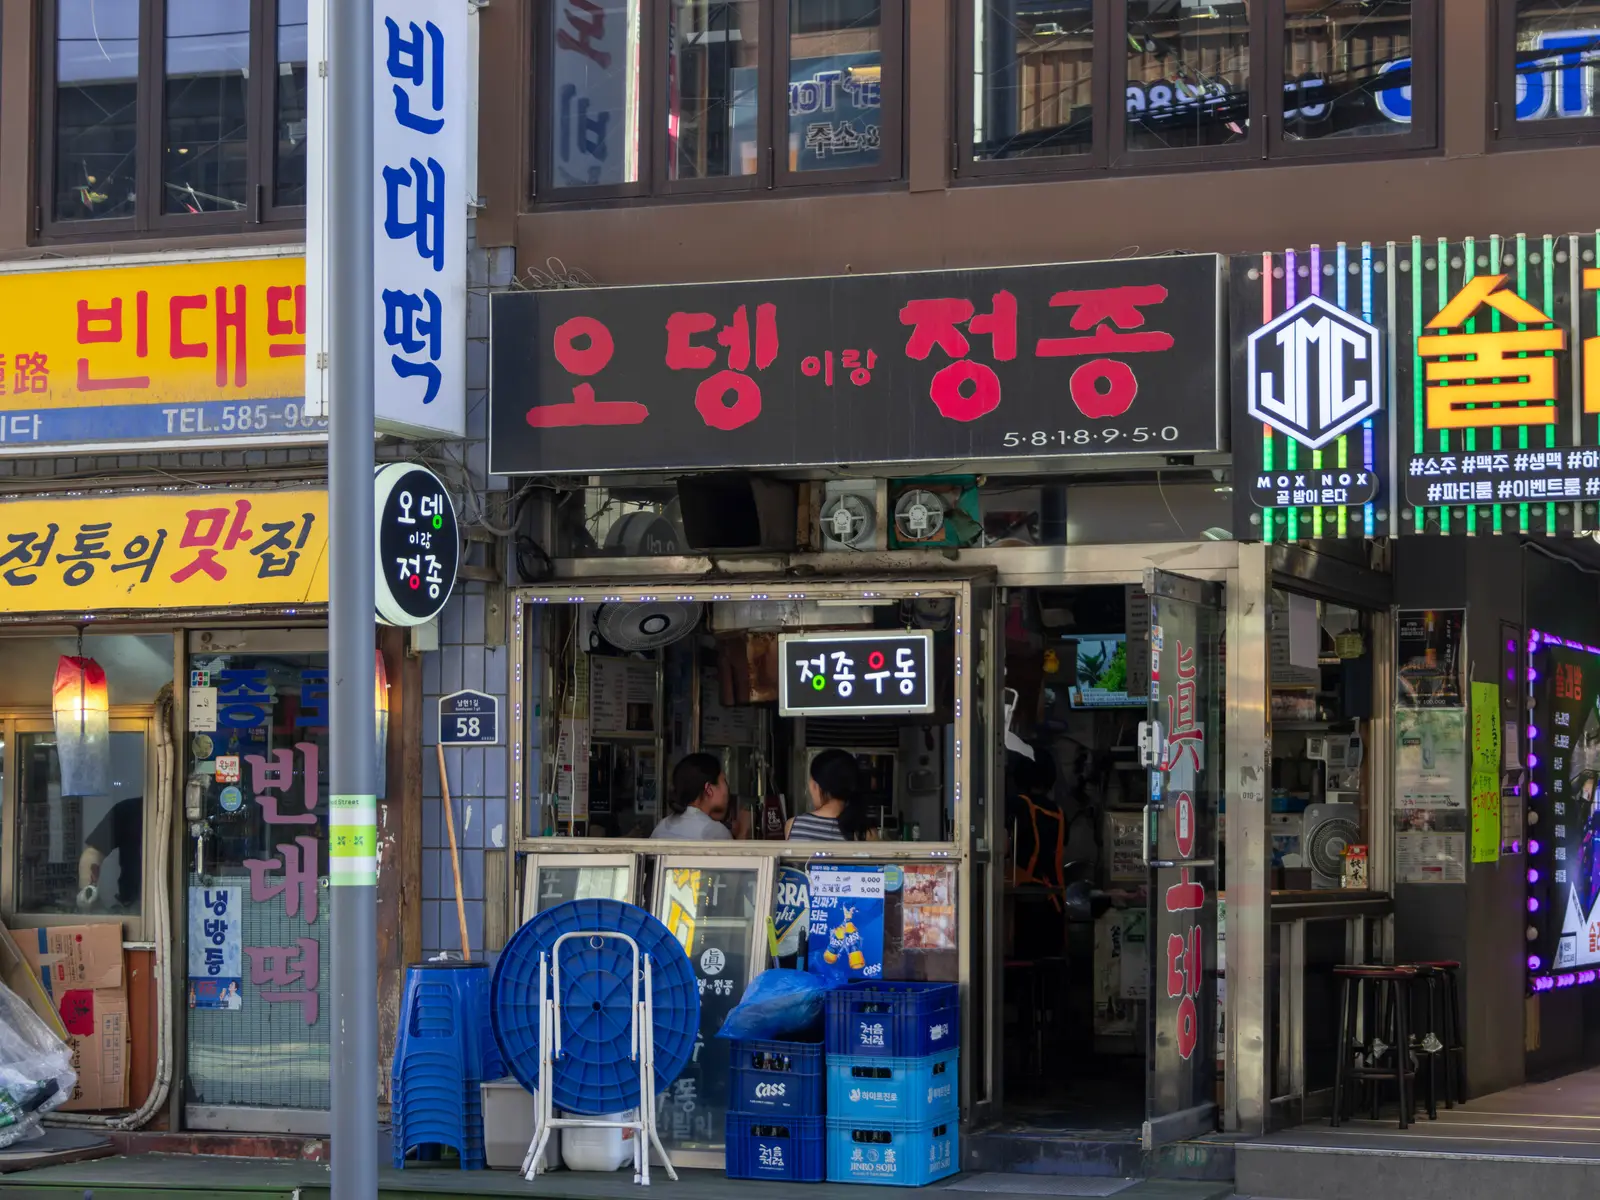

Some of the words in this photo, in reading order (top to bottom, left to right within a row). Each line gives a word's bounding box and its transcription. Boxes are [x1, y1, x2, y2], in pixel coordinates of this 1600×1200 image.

[382, 15, 445, 404] 빈대떡
[526, 302, 779, 431] 오뎅
[801, 348, 878, 386] 이랑
[899, 284, 1175, 422] 정종
[1416, 274, 1600, 429] 술
[1260, 315, 1367, 430] JMC
[1409, 456, 1457, 475] #소주
[1461, 454, 1510, 474] #맥주
[1513, 452, 1562, 471] #생맥
[1257, 475, 1305, 488] MOX
[1321, 473, 1368, 486] NOX
[1427, 480, 1493, 501] #파티룸
[1497, 477, 1581, 498] #이벤트룸
[1293, 488, 1318, 503] 밤이
[1321, 488, 1348, 503] 온다
[397, 491, 443, 529] 오뎅
[2, 522, 168, 587] 전통의
[170, 499, 316, 584] 맛집
[409, 531, 432, 549] 이랑
[396, 554, 443, 599] 정종
[456, 717, 481, 738] 58
[243, 742, 319, 1026] 빈대떡
[811, 896, 838, 909] 진짜가
[810, 909, 829, 922] 되는
[809, 923, 828, 935] 시간
[1589, 922, 1600, 949] 술
[704, 950, 723, 971] 眞
[863, 962, 882, 976] Cass
[714, 979, 734, 996] 정종
[755, 1082, 786, 1099] Cass
[861, 1091, 898, 1102] 하이트진로
[850, 1163, 874, 1171] JINRO
[876, 1163, 897, 1172] SOJU
